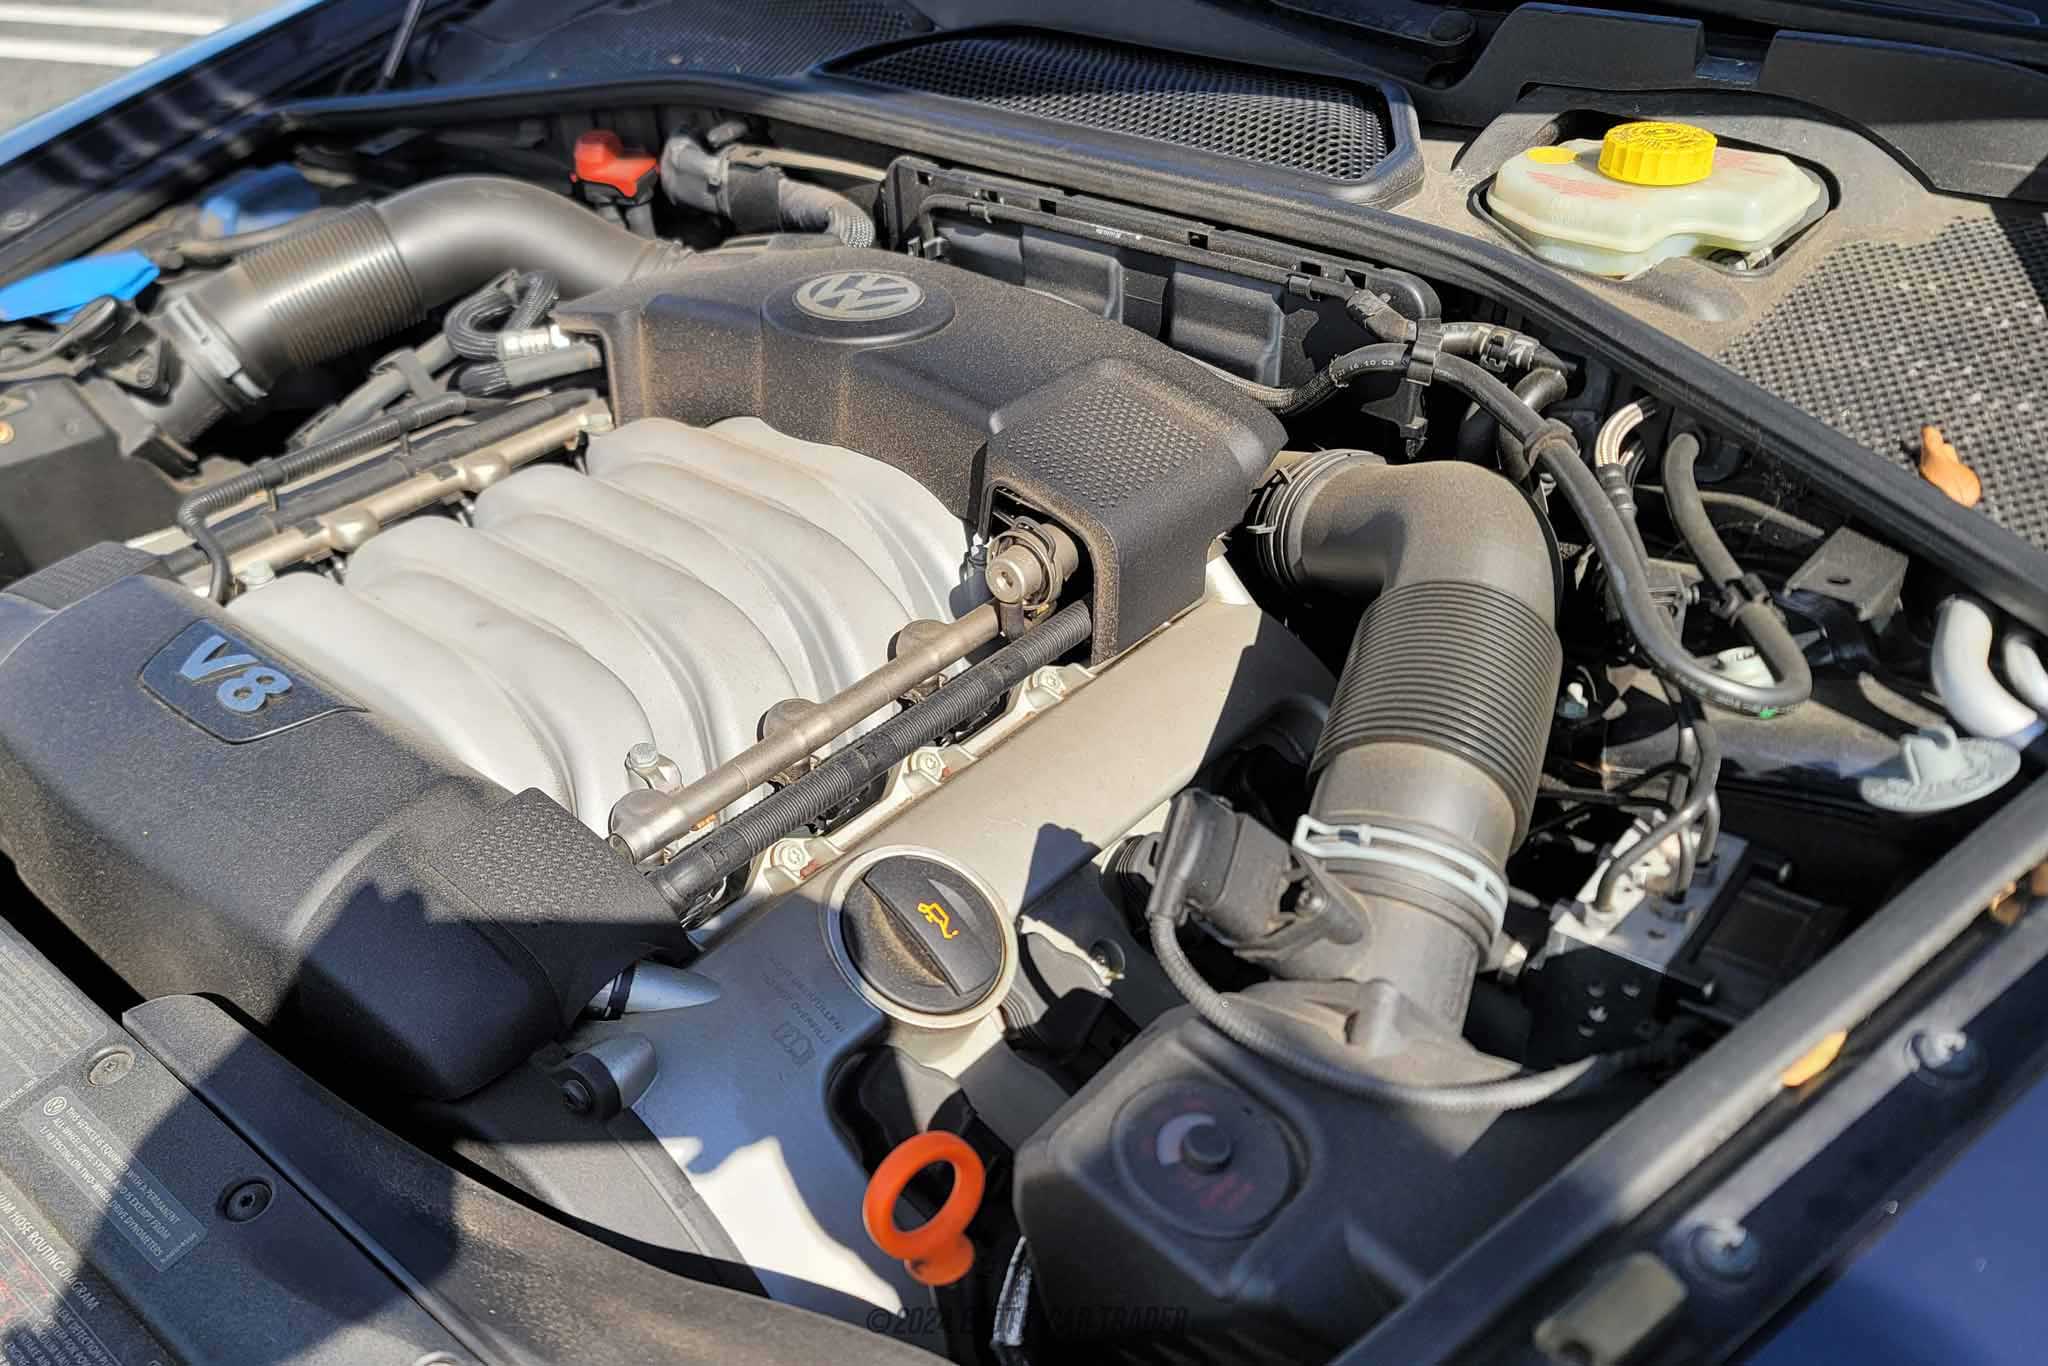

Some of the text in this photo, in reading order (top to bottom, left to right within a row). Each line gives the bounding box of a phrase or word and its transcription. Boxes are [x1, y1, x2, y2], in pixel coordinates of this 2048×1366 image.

[178, 634, 293, 712] V8
[8, 1211, 35, 1236] HOSE
[25, 1229, 66, 1272] ROUTING
[57, 1265, 101, 1311] DIAGRAM
